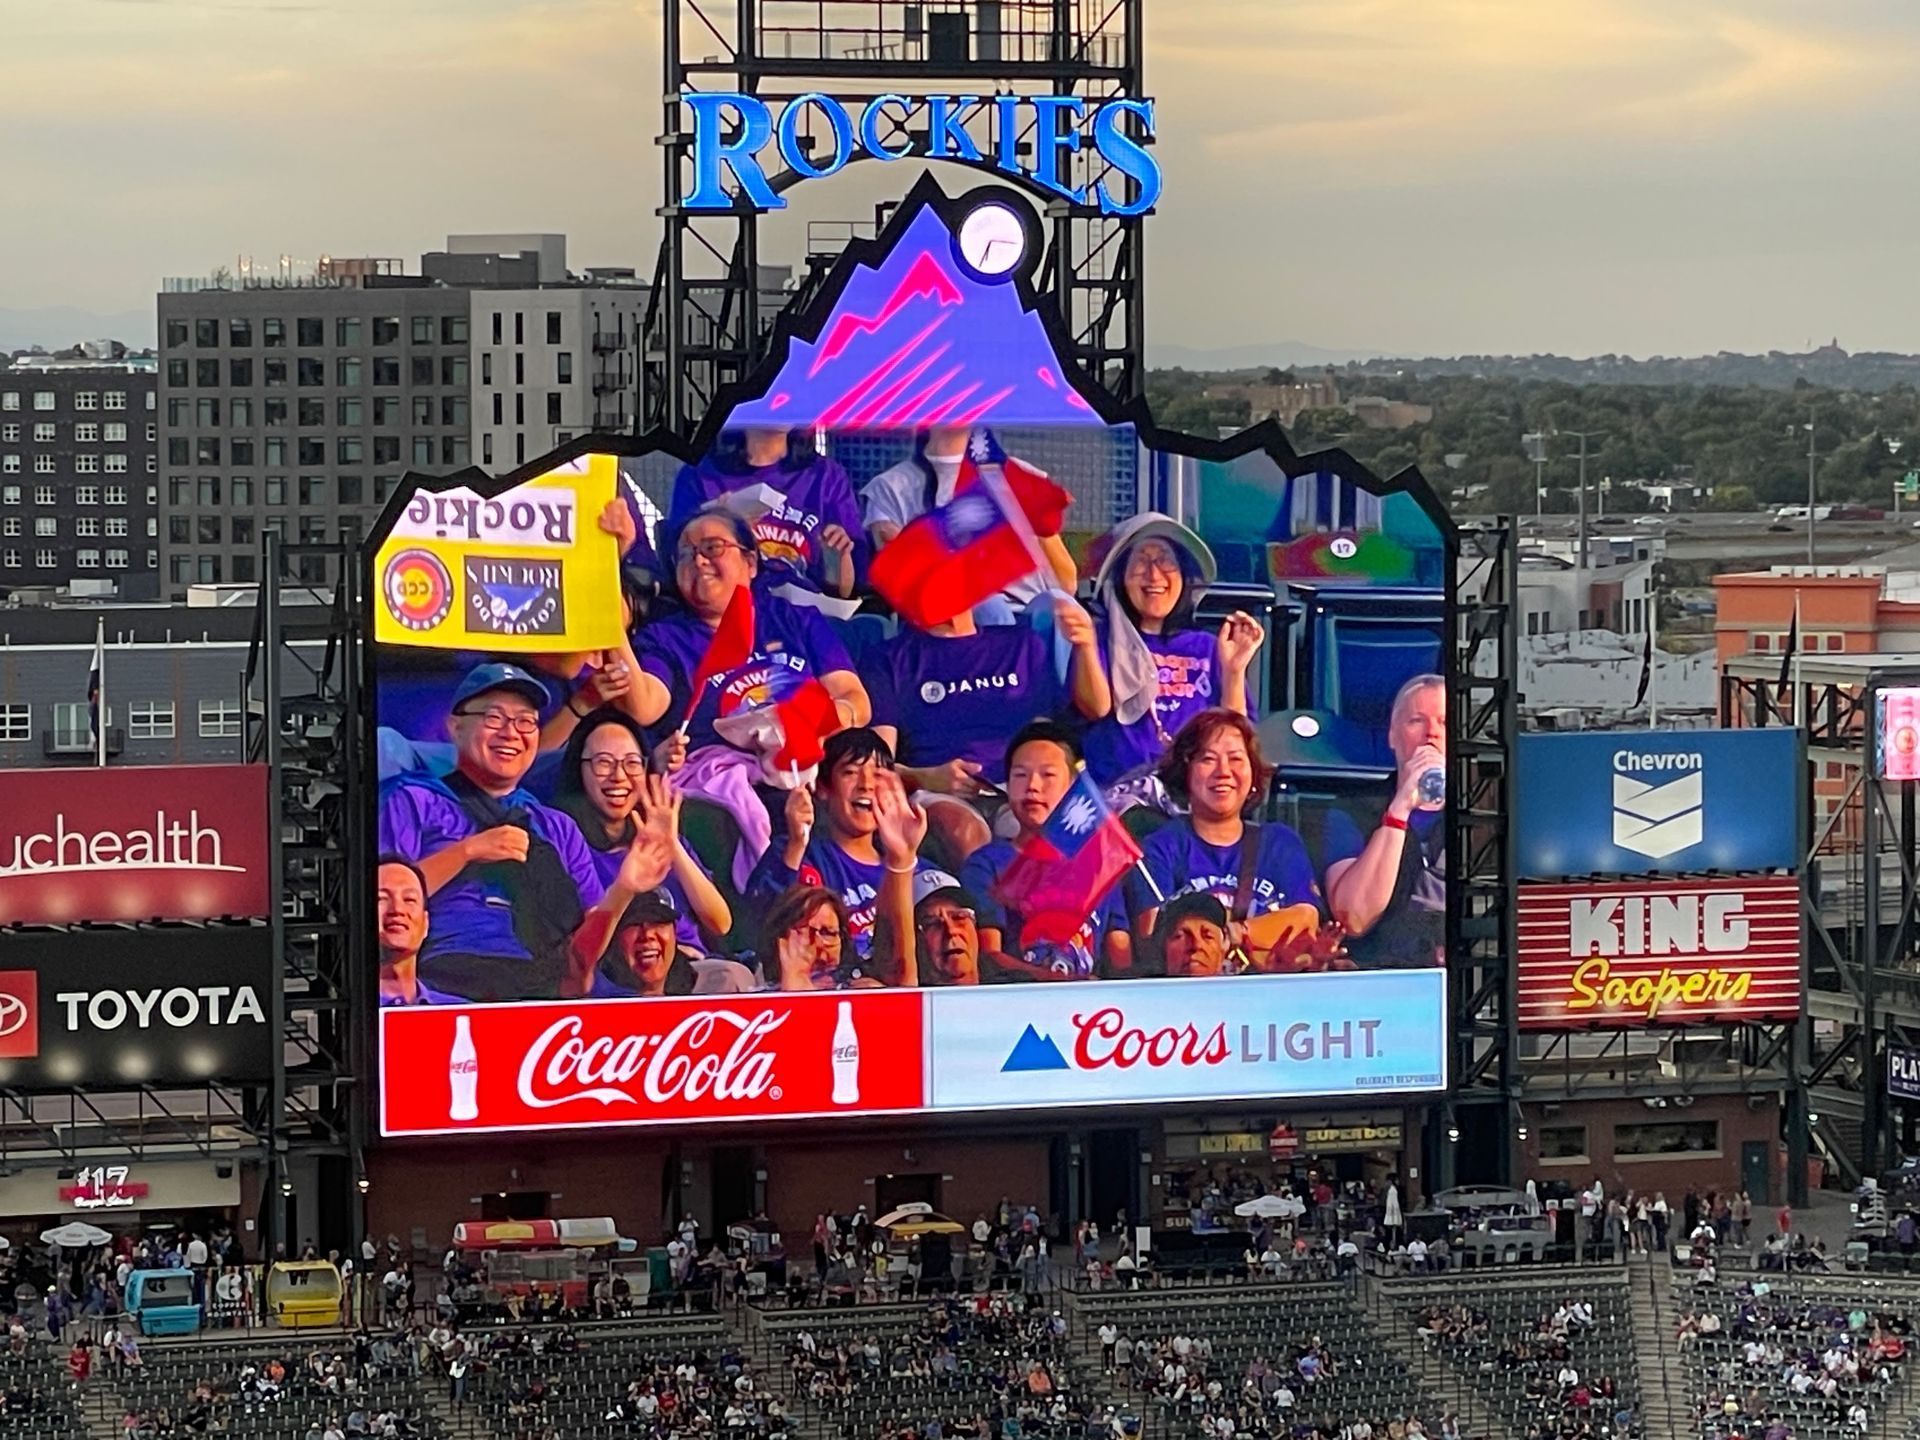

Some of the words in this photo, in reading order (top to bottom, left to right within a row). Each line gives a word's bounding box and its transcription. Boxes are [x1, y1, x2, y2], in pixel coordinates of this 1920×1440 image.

[680, 91, 1163, 216] ROCKIES
[726, 669, 769, 697] TAIW
[948, 672, 1019, 694] JANUS
[1613, 750, 1703, 771] Chevron
[1570, 894, 1750, 957] KING
[56, 986, 266, 1031] TOYOTA
[1566, 958, 1753, 1019] Soopers
[517, 1009, 792, 1108] Coca-Cola
[1072, 1007, 1232, 1070] Coors
[1241, 1019, 1382, 1063] LIGHT
[1892, 1055, 1920, 1081] PLA
[1363, 1126, 1400, 1139] DOG
